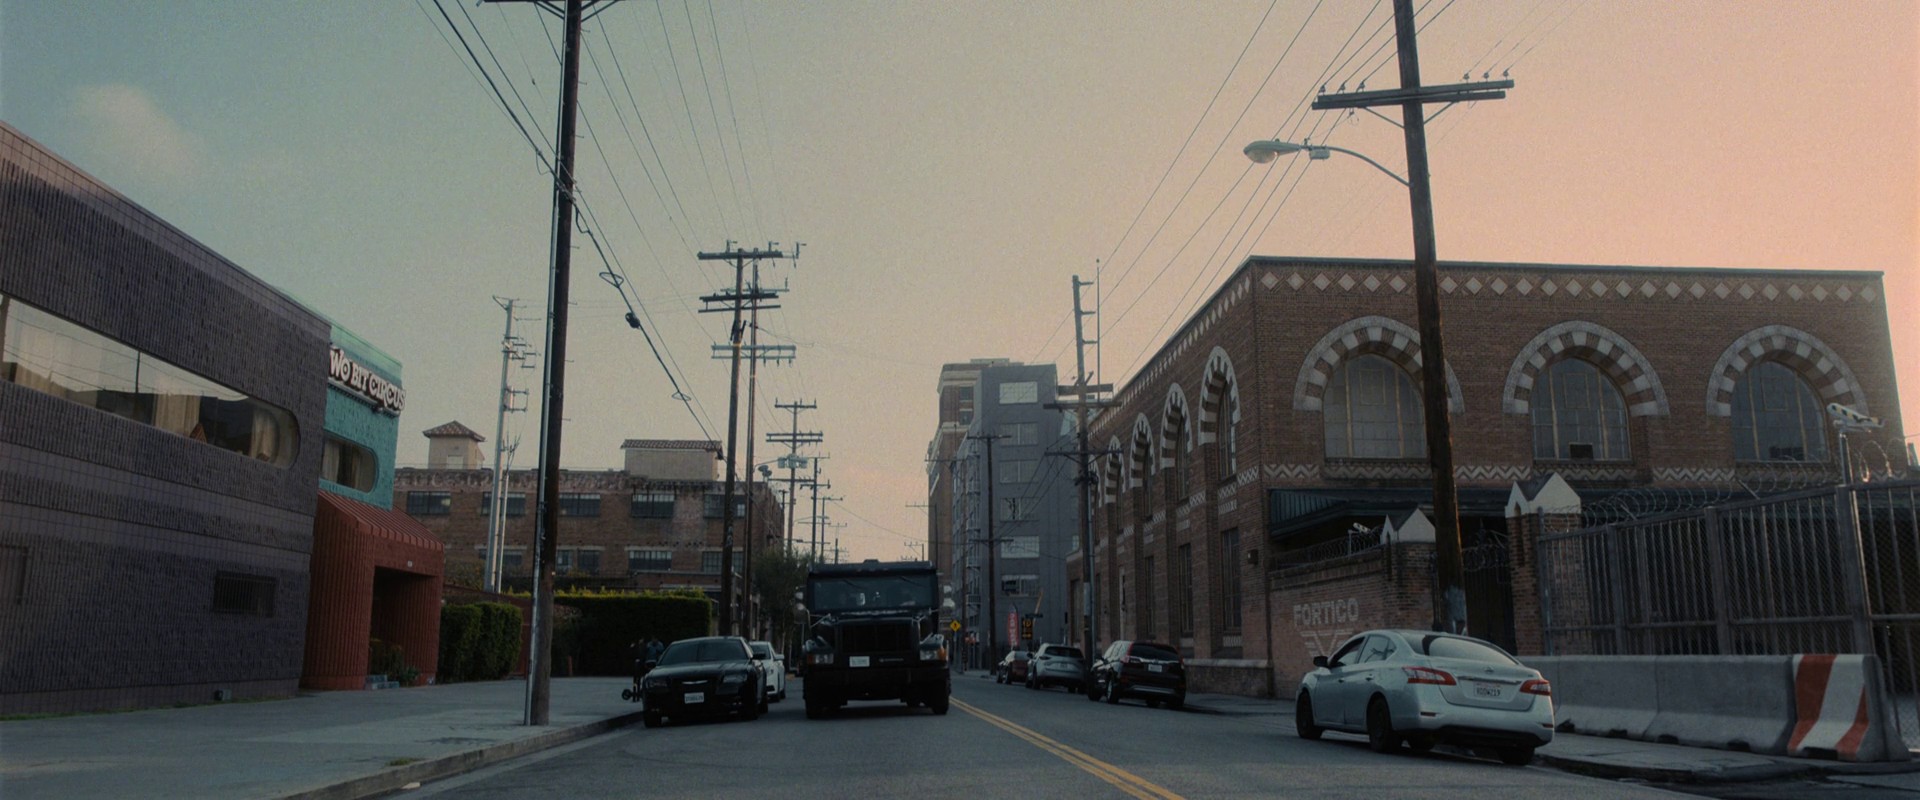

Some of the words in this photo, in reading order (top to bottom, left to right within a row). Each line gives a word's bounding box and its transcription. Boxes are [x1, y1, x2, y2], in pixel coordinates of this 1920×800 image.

[329, 348, 351, 383] WO
[350, 362, 370, 392] BIT
[368, 373, 405, 410] CIRCUS
[1293, 598, 1360, 627] FORTICO
